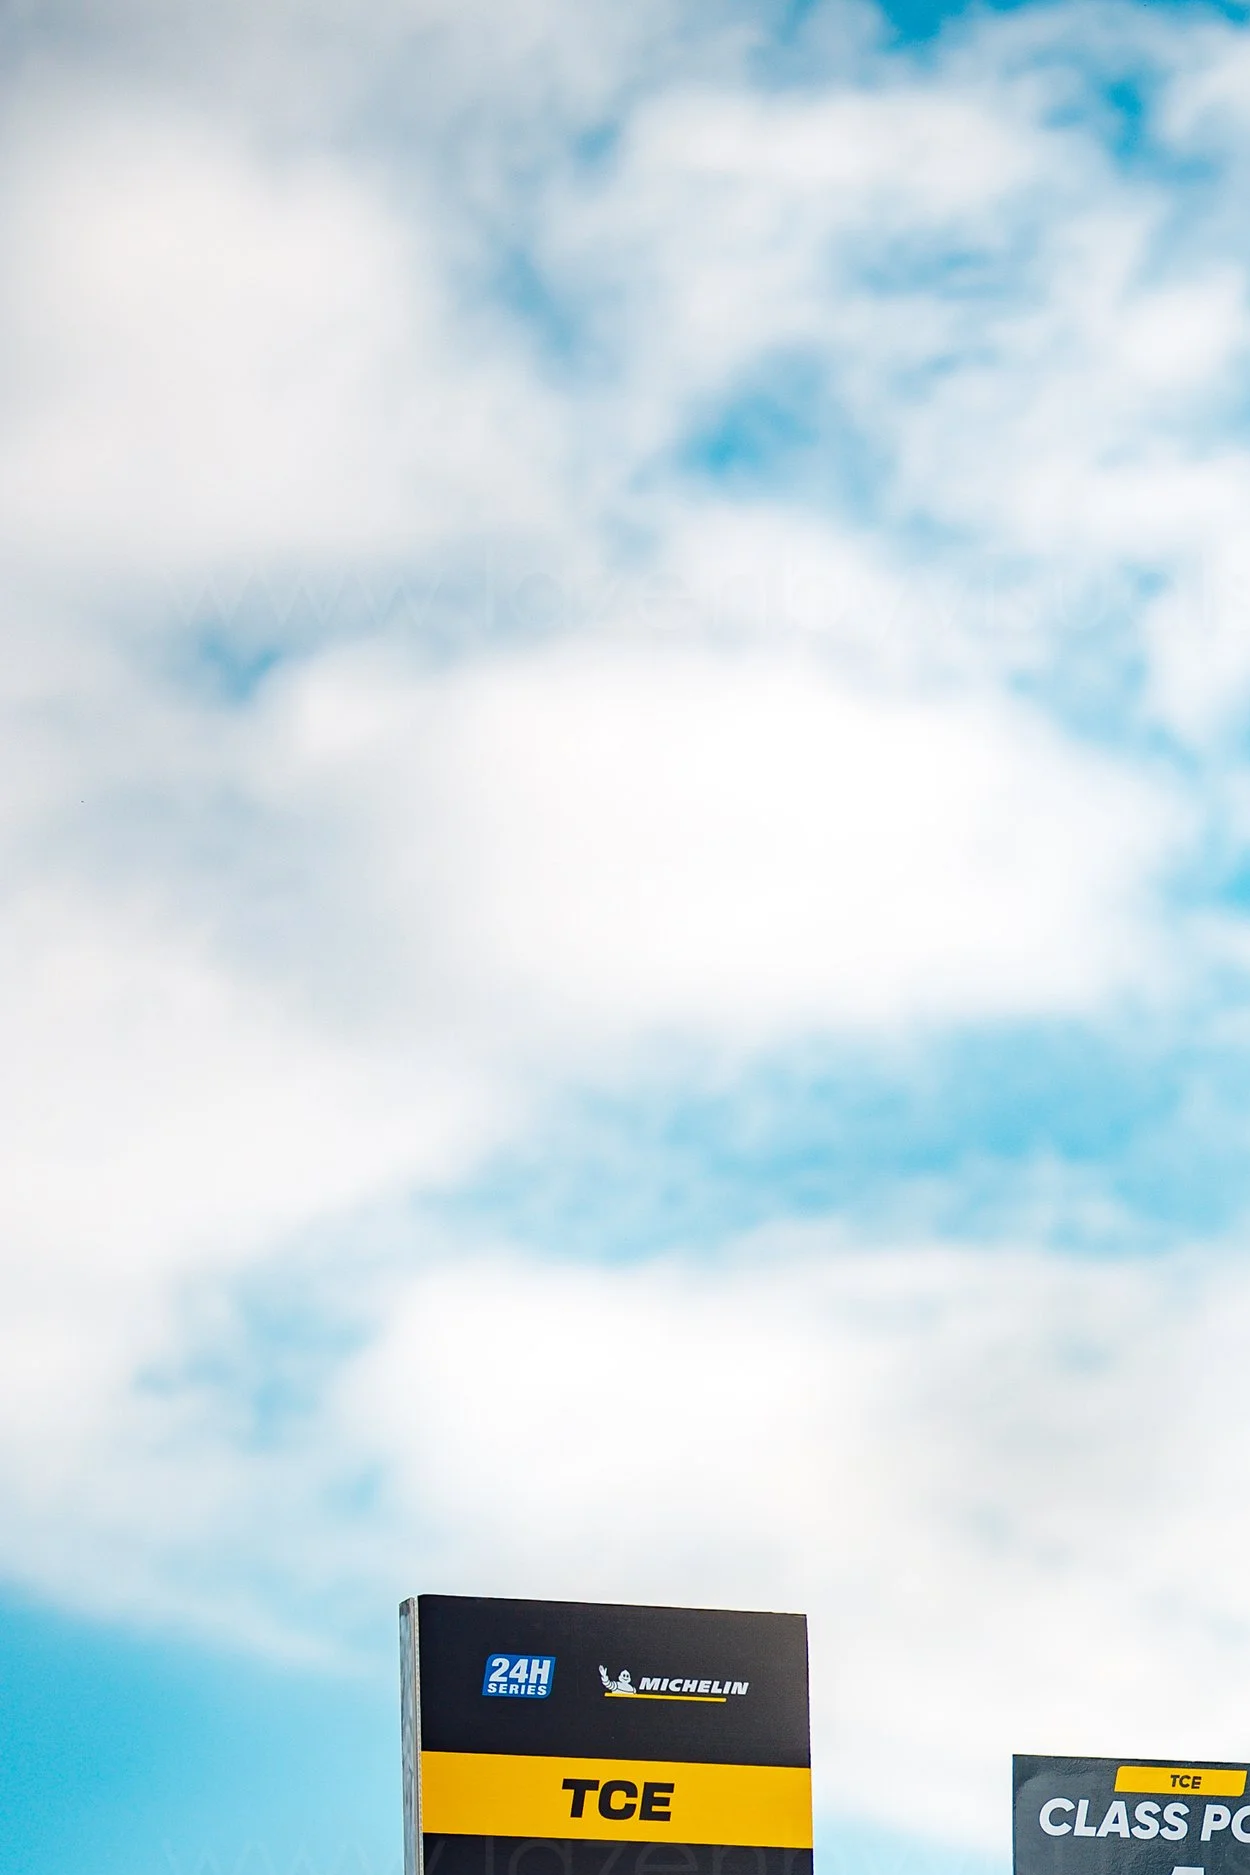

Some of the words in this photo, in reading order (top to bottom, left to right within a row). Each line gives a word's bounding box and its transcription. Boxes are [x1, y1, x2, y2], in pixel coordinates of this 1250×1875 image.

[489, 1657, 551, 1684] 24H
[487, 1683, 547, 1696] SERIES
[638, 1676, 749, 1696] MICHELIN
[1170, 1774, 1202, 1789] TCE
[561, 1778, 675, 1822] TCE
[1038, 1797, 1190, 1841] CLASS
